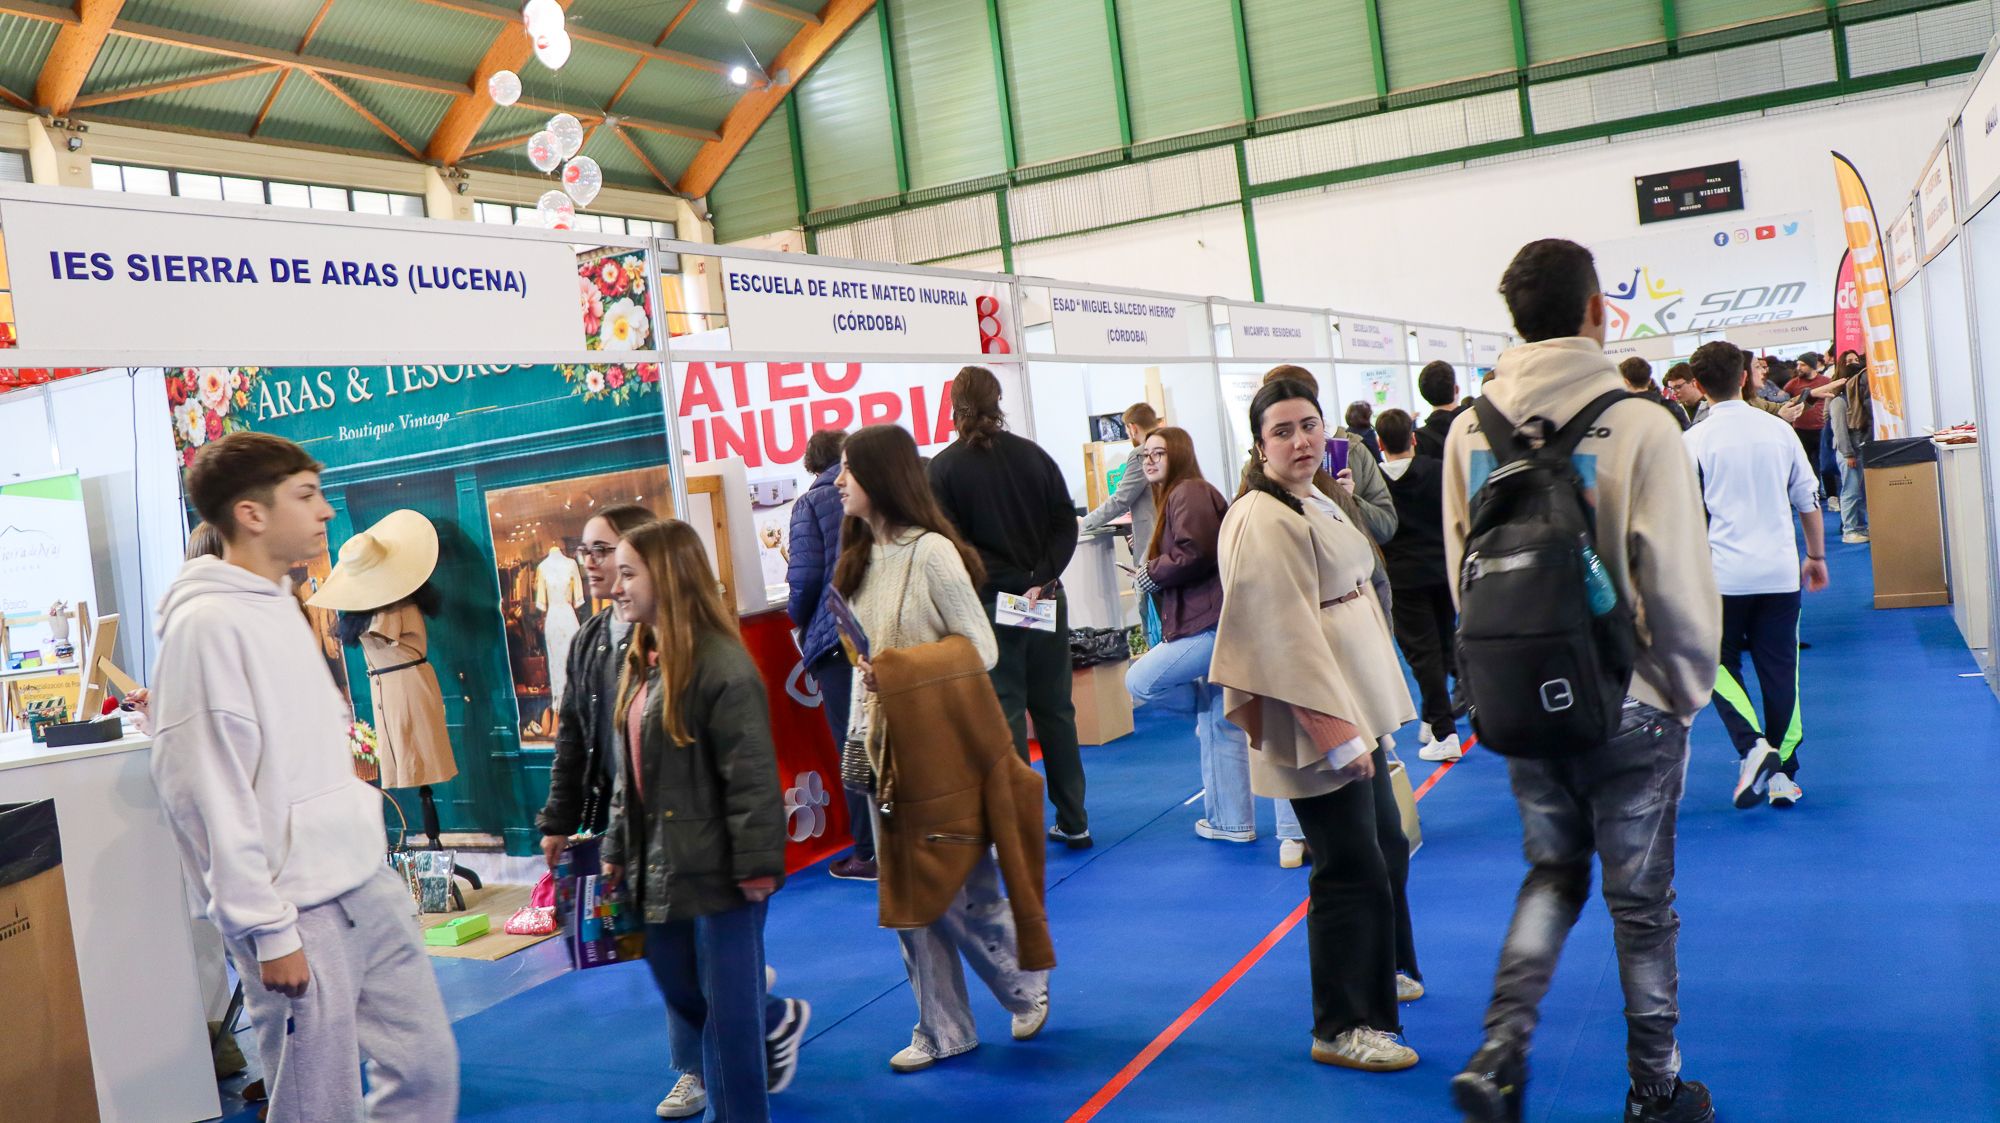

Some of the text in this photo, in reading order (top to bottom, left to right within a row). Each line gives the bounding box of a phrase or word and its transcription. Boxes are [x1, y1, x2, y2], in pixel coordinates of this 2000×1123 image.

[1653, 196, 1671, 204] LOCAL
[49, 250, 527, 299] IES SIERRA DE ARAS (LUCENA)
[729, 272, 969, 307] ESCUELA DE ARTE MATEO INURRIA
[1081, 299, 1113, 314] MIGUEL
[1114, 302, 1148, 317] SALCEDO
[1695, 281, 1807, 316] SDM
[833, 310, 907, 336] (CÓRDOBA)
[1687, 309, 1794, 332] Lucena
[257, 370, 337, 422] ARAS
[346, 366, 374, 403] &
[339, 411, 450, 441] Boutique Vintage
